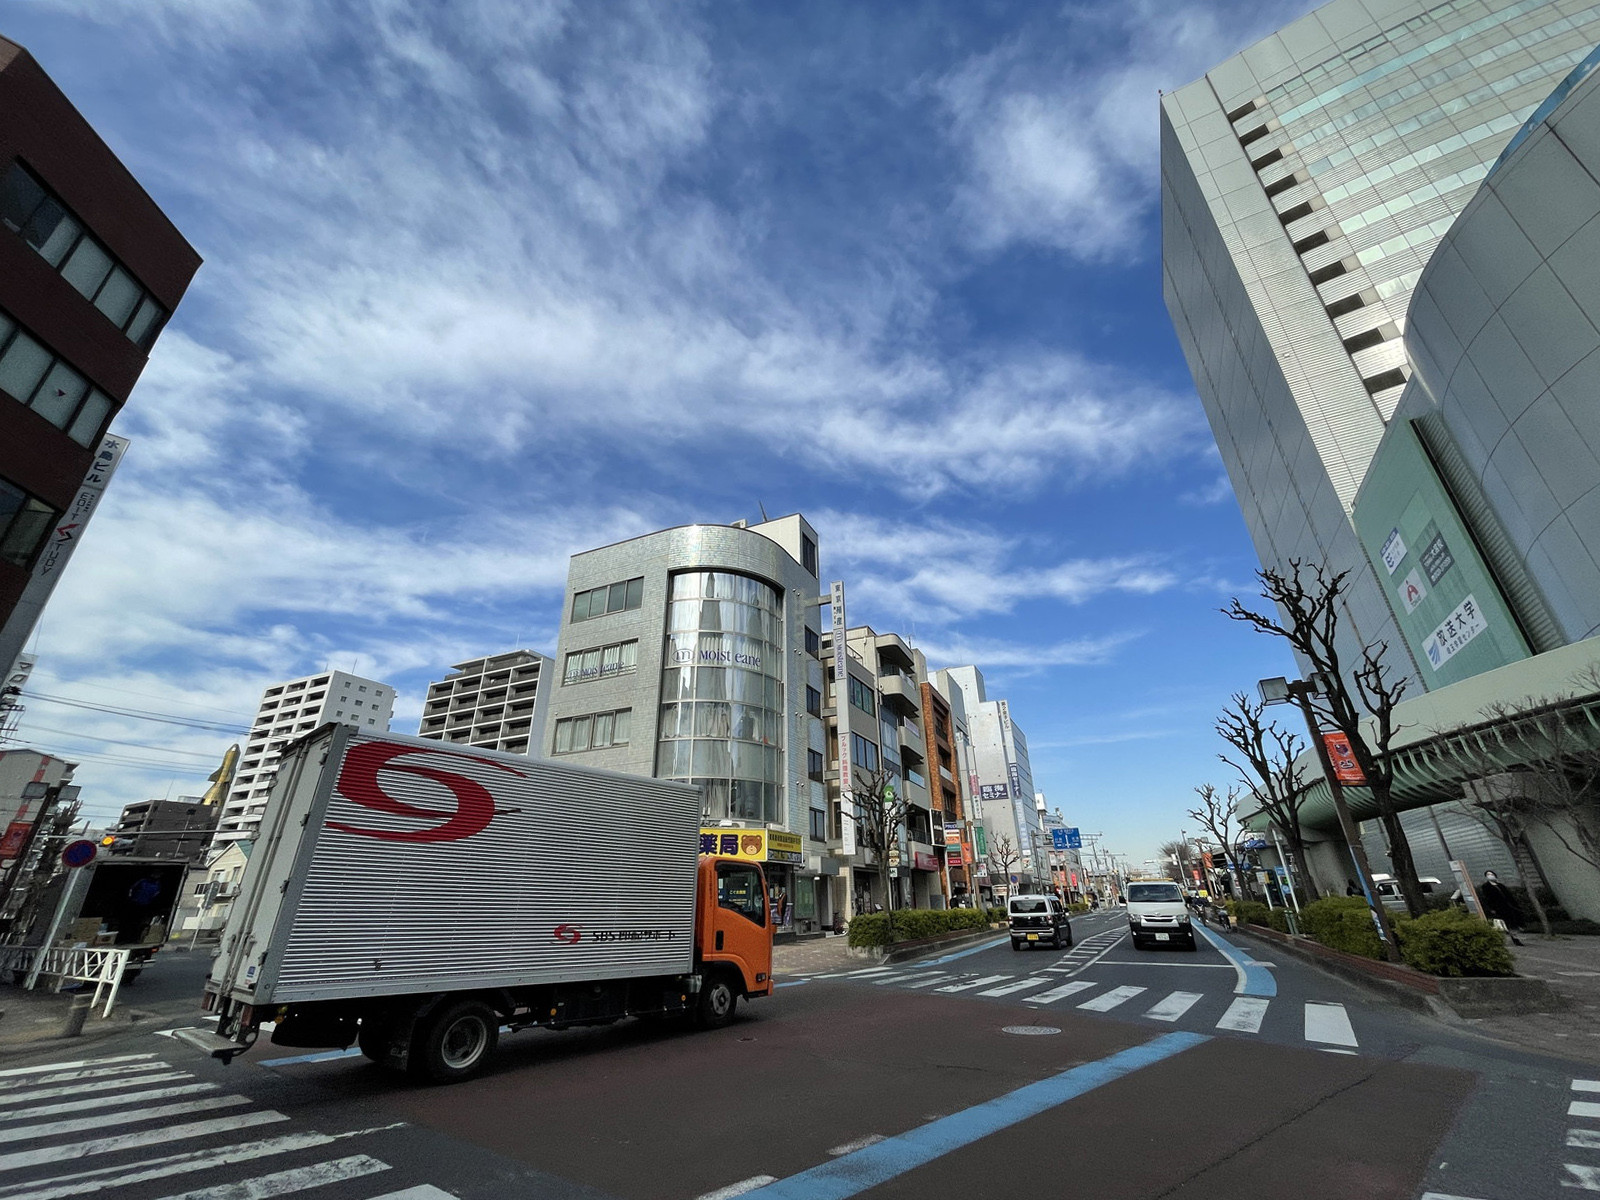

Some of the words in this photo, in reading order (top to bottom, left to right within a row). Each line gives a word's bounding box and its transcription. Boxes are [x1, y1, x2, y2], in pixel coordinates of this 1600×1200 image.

[1436, 600, 1475, 647] 放送大学
[699, 832, 739, 856] 薬局
